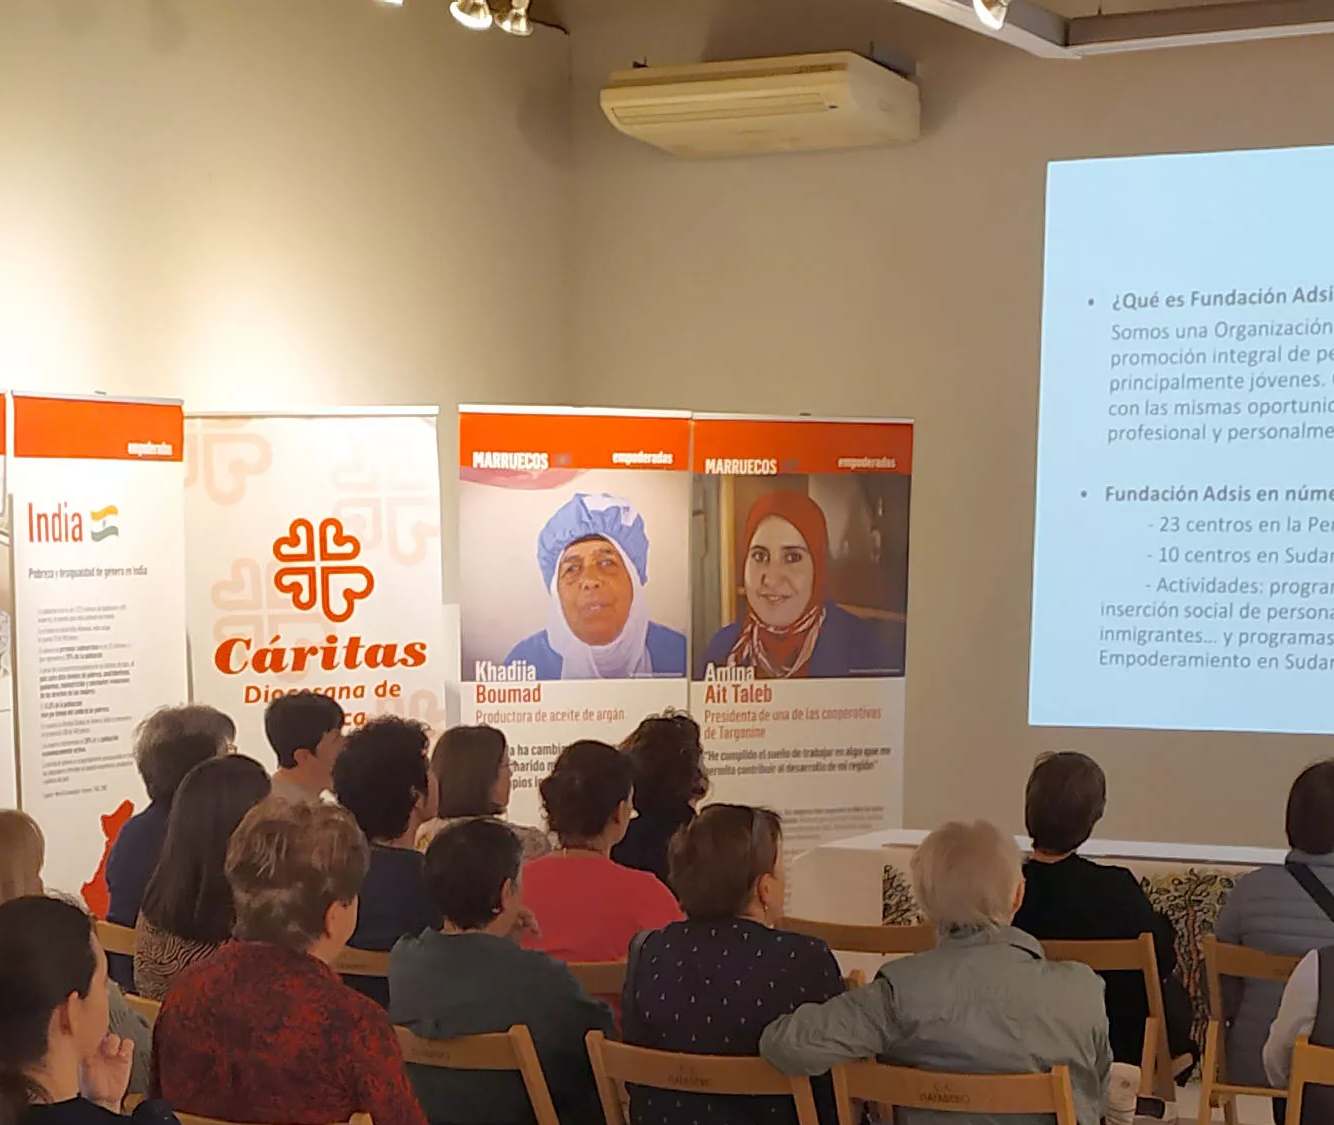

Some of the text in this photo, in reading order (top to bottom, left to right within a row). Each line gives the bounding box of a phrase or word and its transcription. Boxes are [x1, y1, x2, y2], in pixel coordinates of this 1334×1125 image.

[1112, 290, 1160, 313] ¿Qué
[1165, 294, 1185, 309] es
[1190, 286, 1287, 308] Fundación
[1111, 322, 1170, 342] Somos
[1175, 324, 1208, 340] una
[1214, 315, 1334, 343] Organización
[1109, 372, 1245, 396] principalmente
[1247, 370, 1326, 394] jóvenes.
[472, 451, 549, 470] MARRUECOS
[705, 457, 777, 475] MARRUECOS
[1105, 483, 1199, 503] Fundación
[1202, 484, 1252, 503] Adsis
[1256, 488, 1279, 503] en
[28, 502, 83, 543] India
[1159, 515, 1181, 533] 23
[1185, 517, 1254, 533] centros
[1258, 519, 1281, 534] en
[1286, 515, 1302, 533] la
[1158, 545, 1180, 564] 10
[1184, 548, 1252, 565] centros
[1256, 549, 1279, 565] en
[1155, 575, 1264, 595] Actividades:
[1223, 630, 1234, 648] y
[1238, 631, 1334, 649] programas
[215, 634, 427, 675] Cáritas
[1099, 648, 1252, 670] Empoderamiento
[1256, 656, 1279, 671] en
[475, 660, 537, 682] Khadija
[704, 662, 755, 682] Amina
[374, 680, 401, 698] de
[476, 683, 542, 704] Boumad
[705, 683, 773, 704] Ait Taleb
